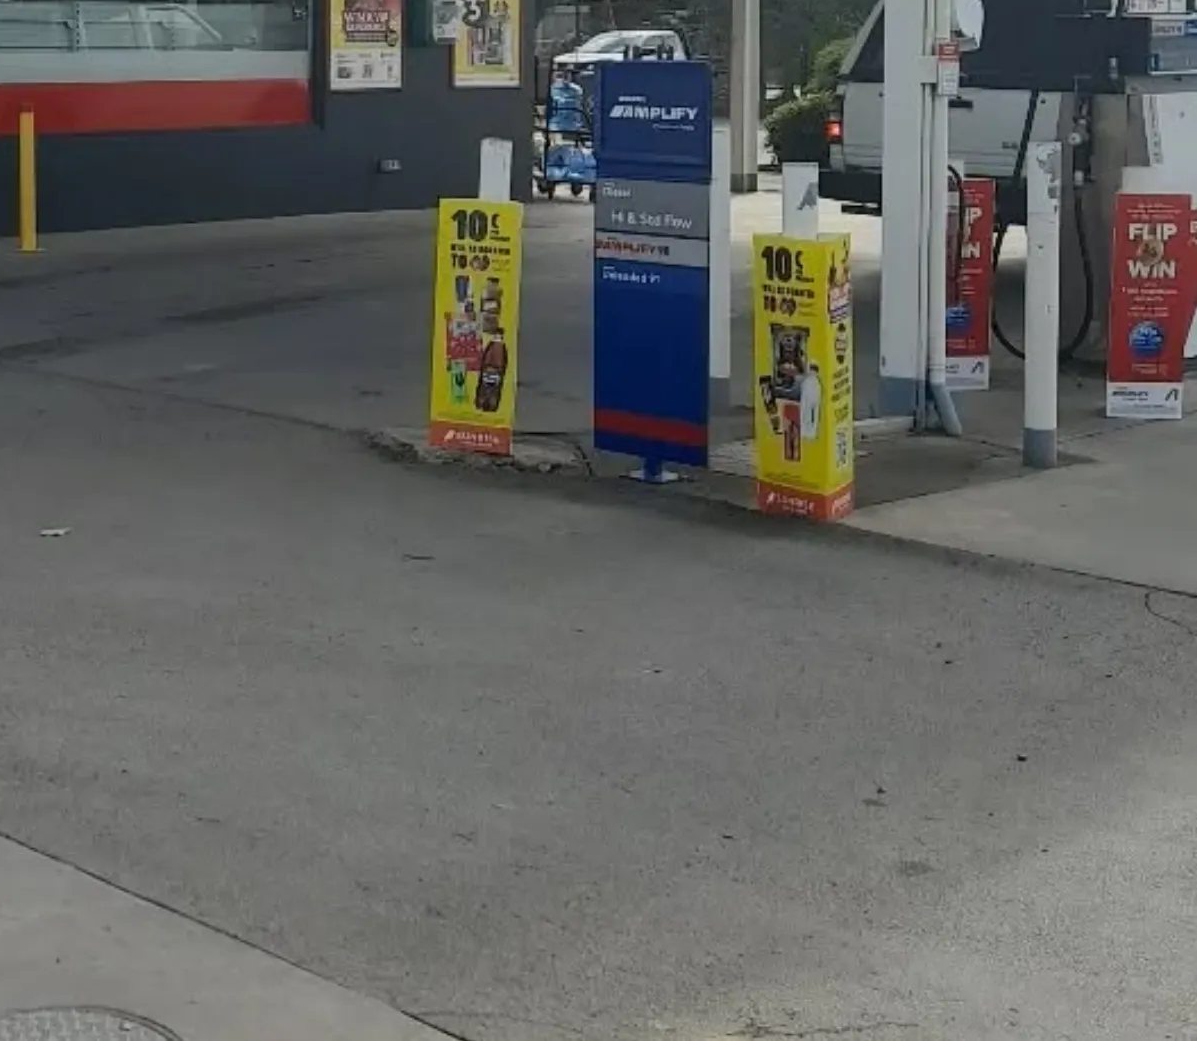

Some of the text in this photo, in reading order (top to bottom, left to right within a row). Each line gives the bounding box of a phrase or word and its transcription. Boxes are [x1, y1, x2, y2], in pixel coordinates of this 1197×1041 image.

[609, 105, 699, 121] AMPLIFY
[1127, 222, 1178, 241] FLIP
[1127, 260, 1176, 279] WIN
